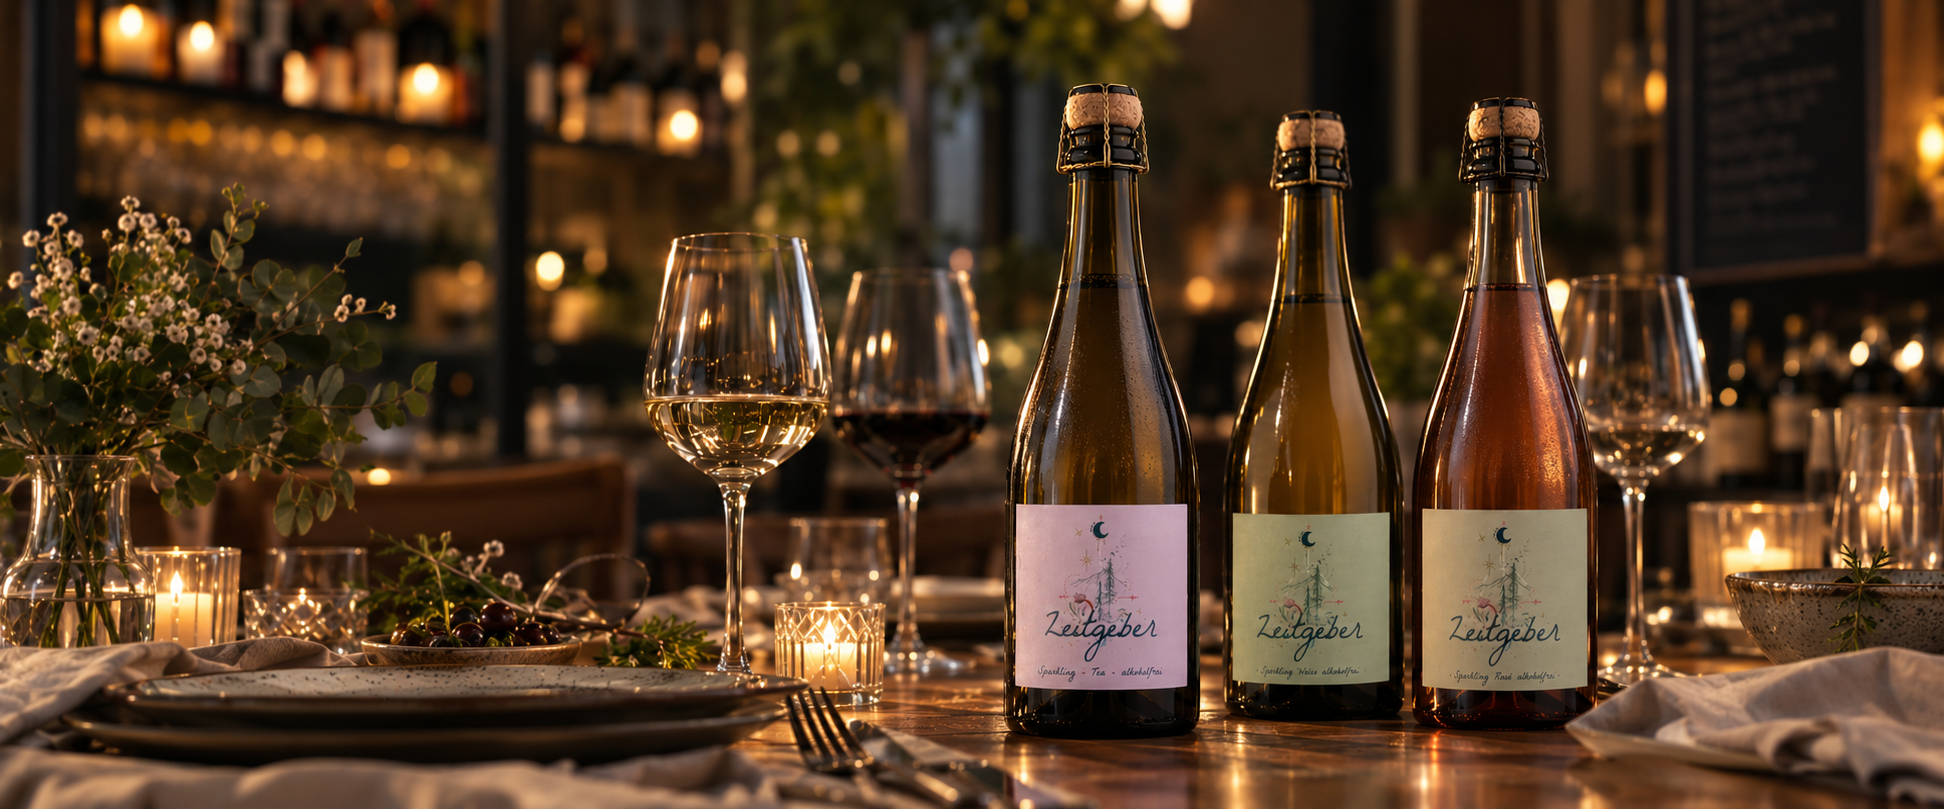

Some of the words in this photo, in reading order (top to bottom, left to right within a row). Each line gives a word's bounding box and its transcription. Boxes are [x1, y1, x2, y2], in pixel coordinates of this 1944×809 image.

[1045, 609, 1158, 663] Zeitgeber
[1256, 614, 1364, 663] Zeitgeber
[1449, 615, 1561, 667] Zeitgeber
[1037, 665, 1076, 683] Sparkling
[1091, 667, 1106, 677] Tea
